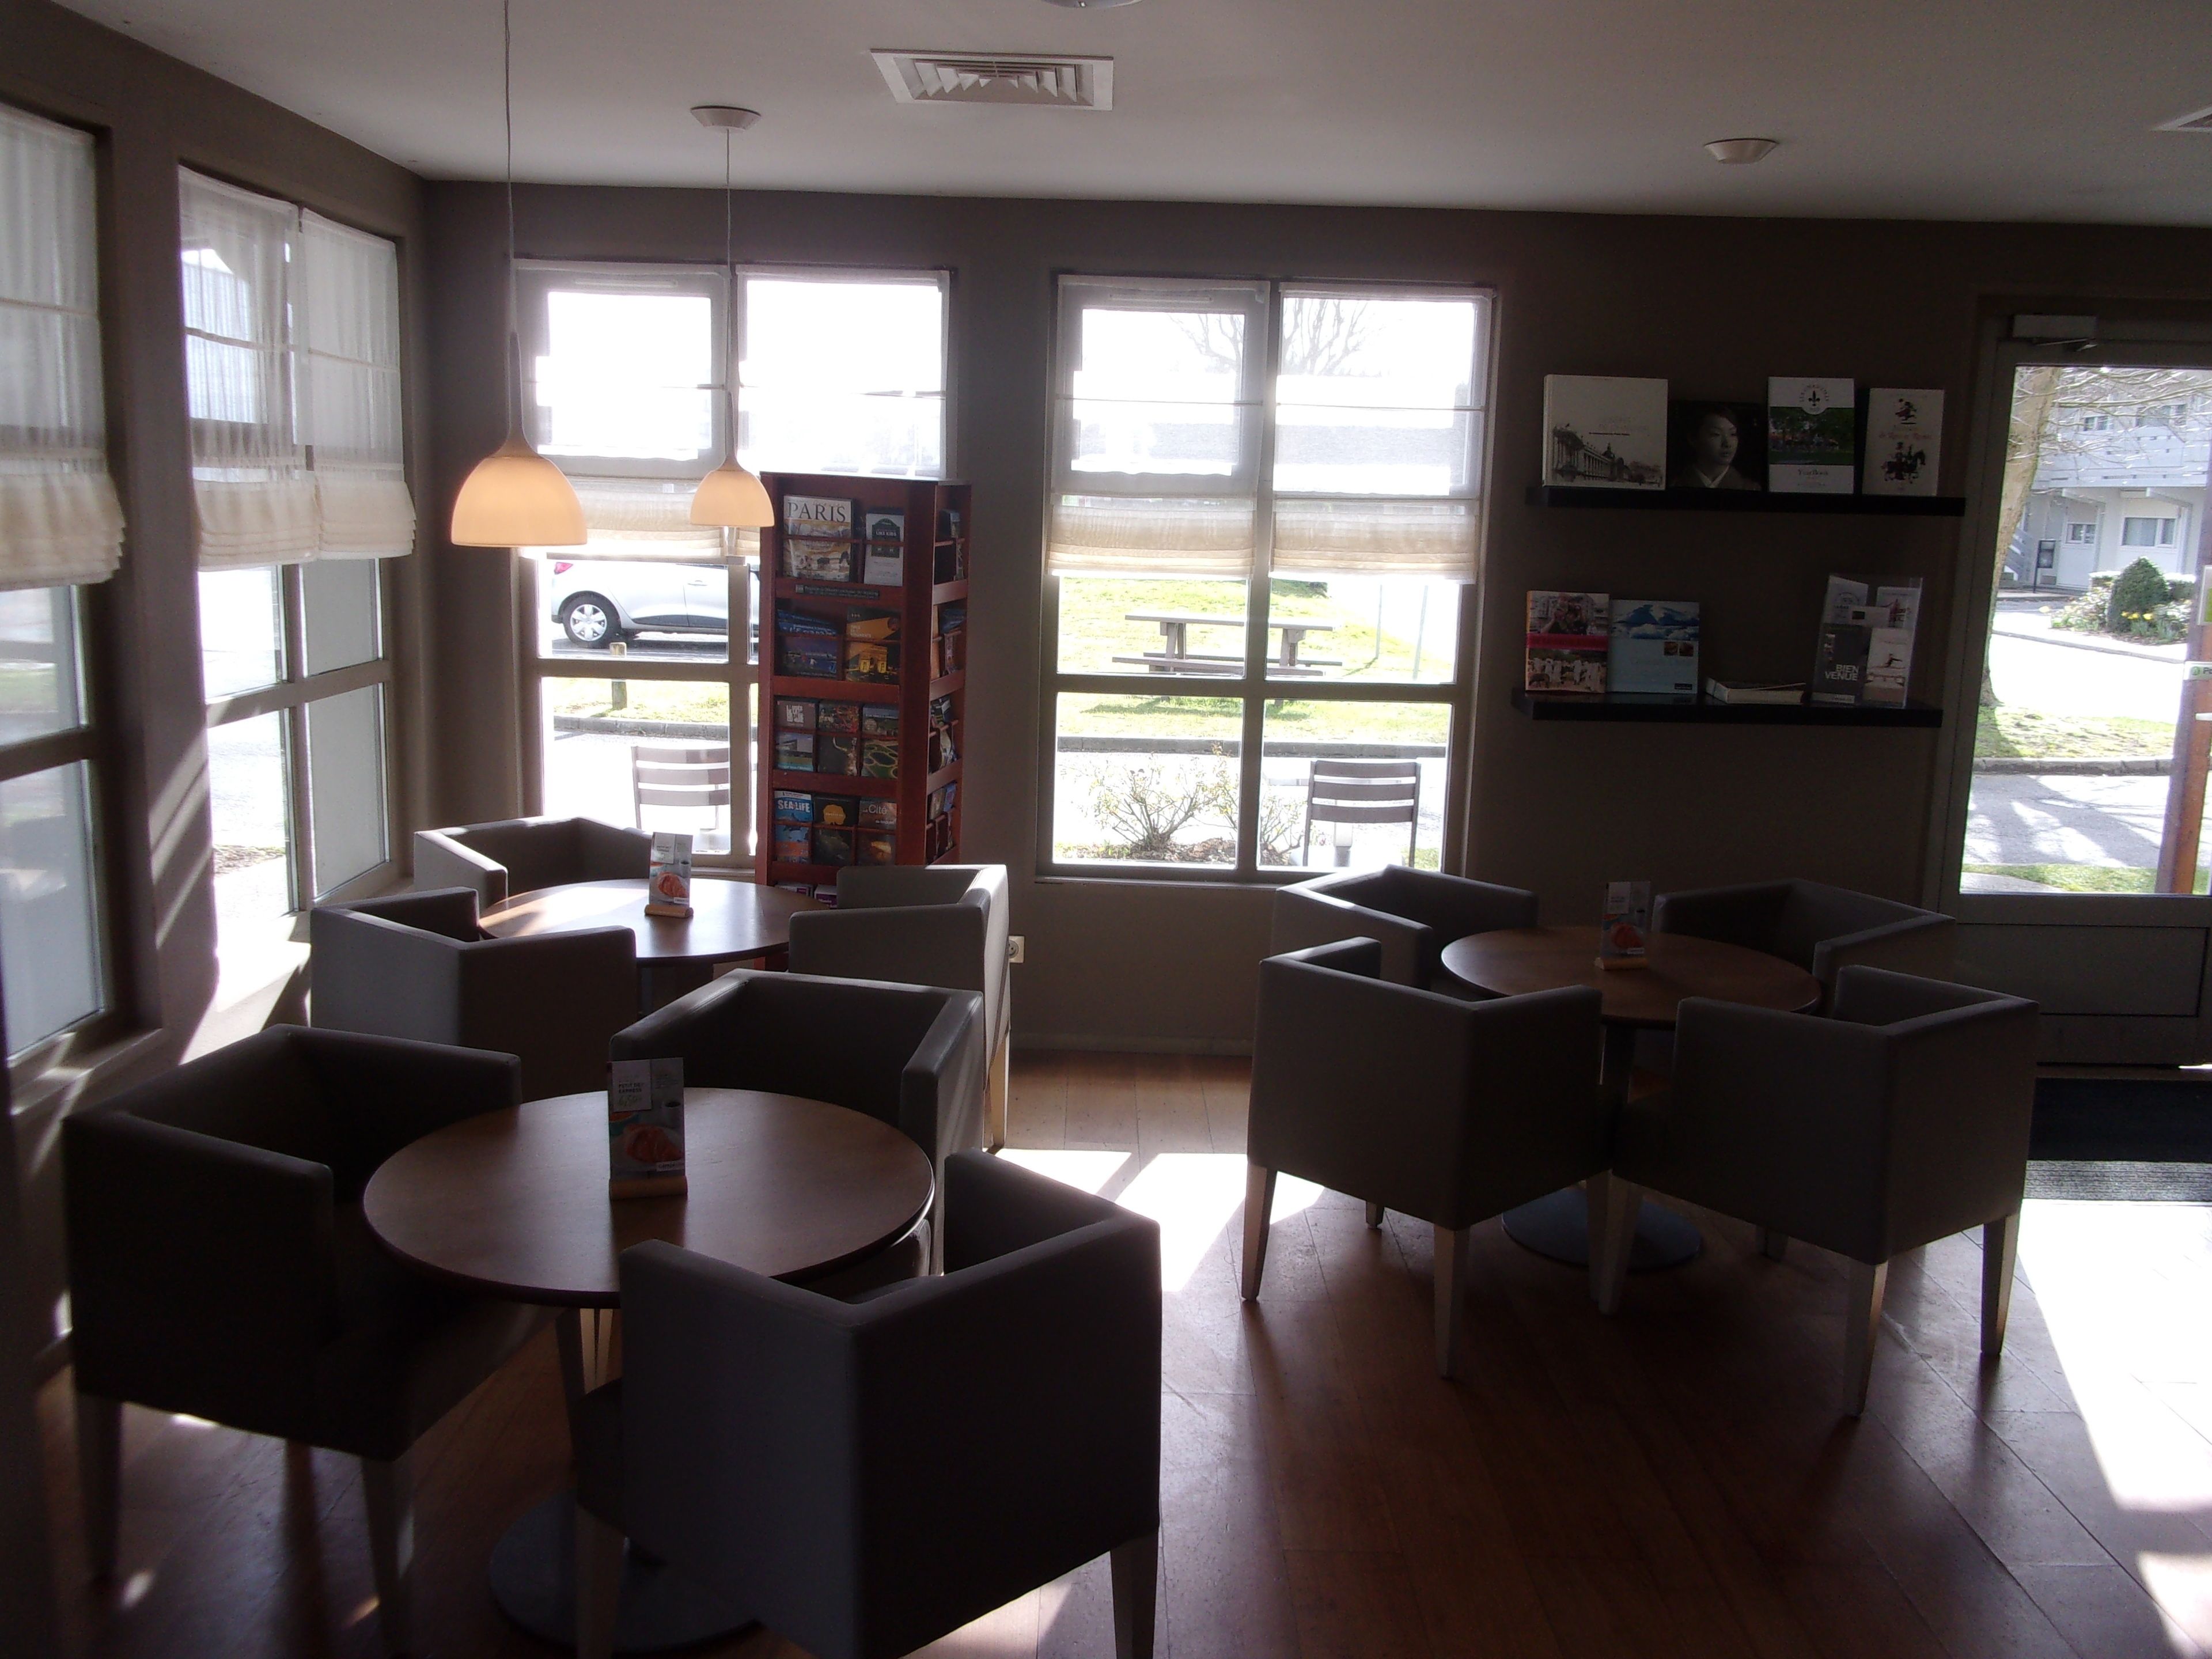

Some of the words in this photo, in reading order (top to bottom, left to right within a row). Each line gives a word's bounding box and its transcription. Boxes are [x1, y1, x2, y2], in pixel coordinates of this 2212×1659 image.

[787, 502, 846, 523] PARIS
[1836, 664, 1859, 673] BIEN
[1825, 671, 1858, 681] VENUE
[778, 800, 794, 810] SEA
[869, 804, 888, 815] Cité
